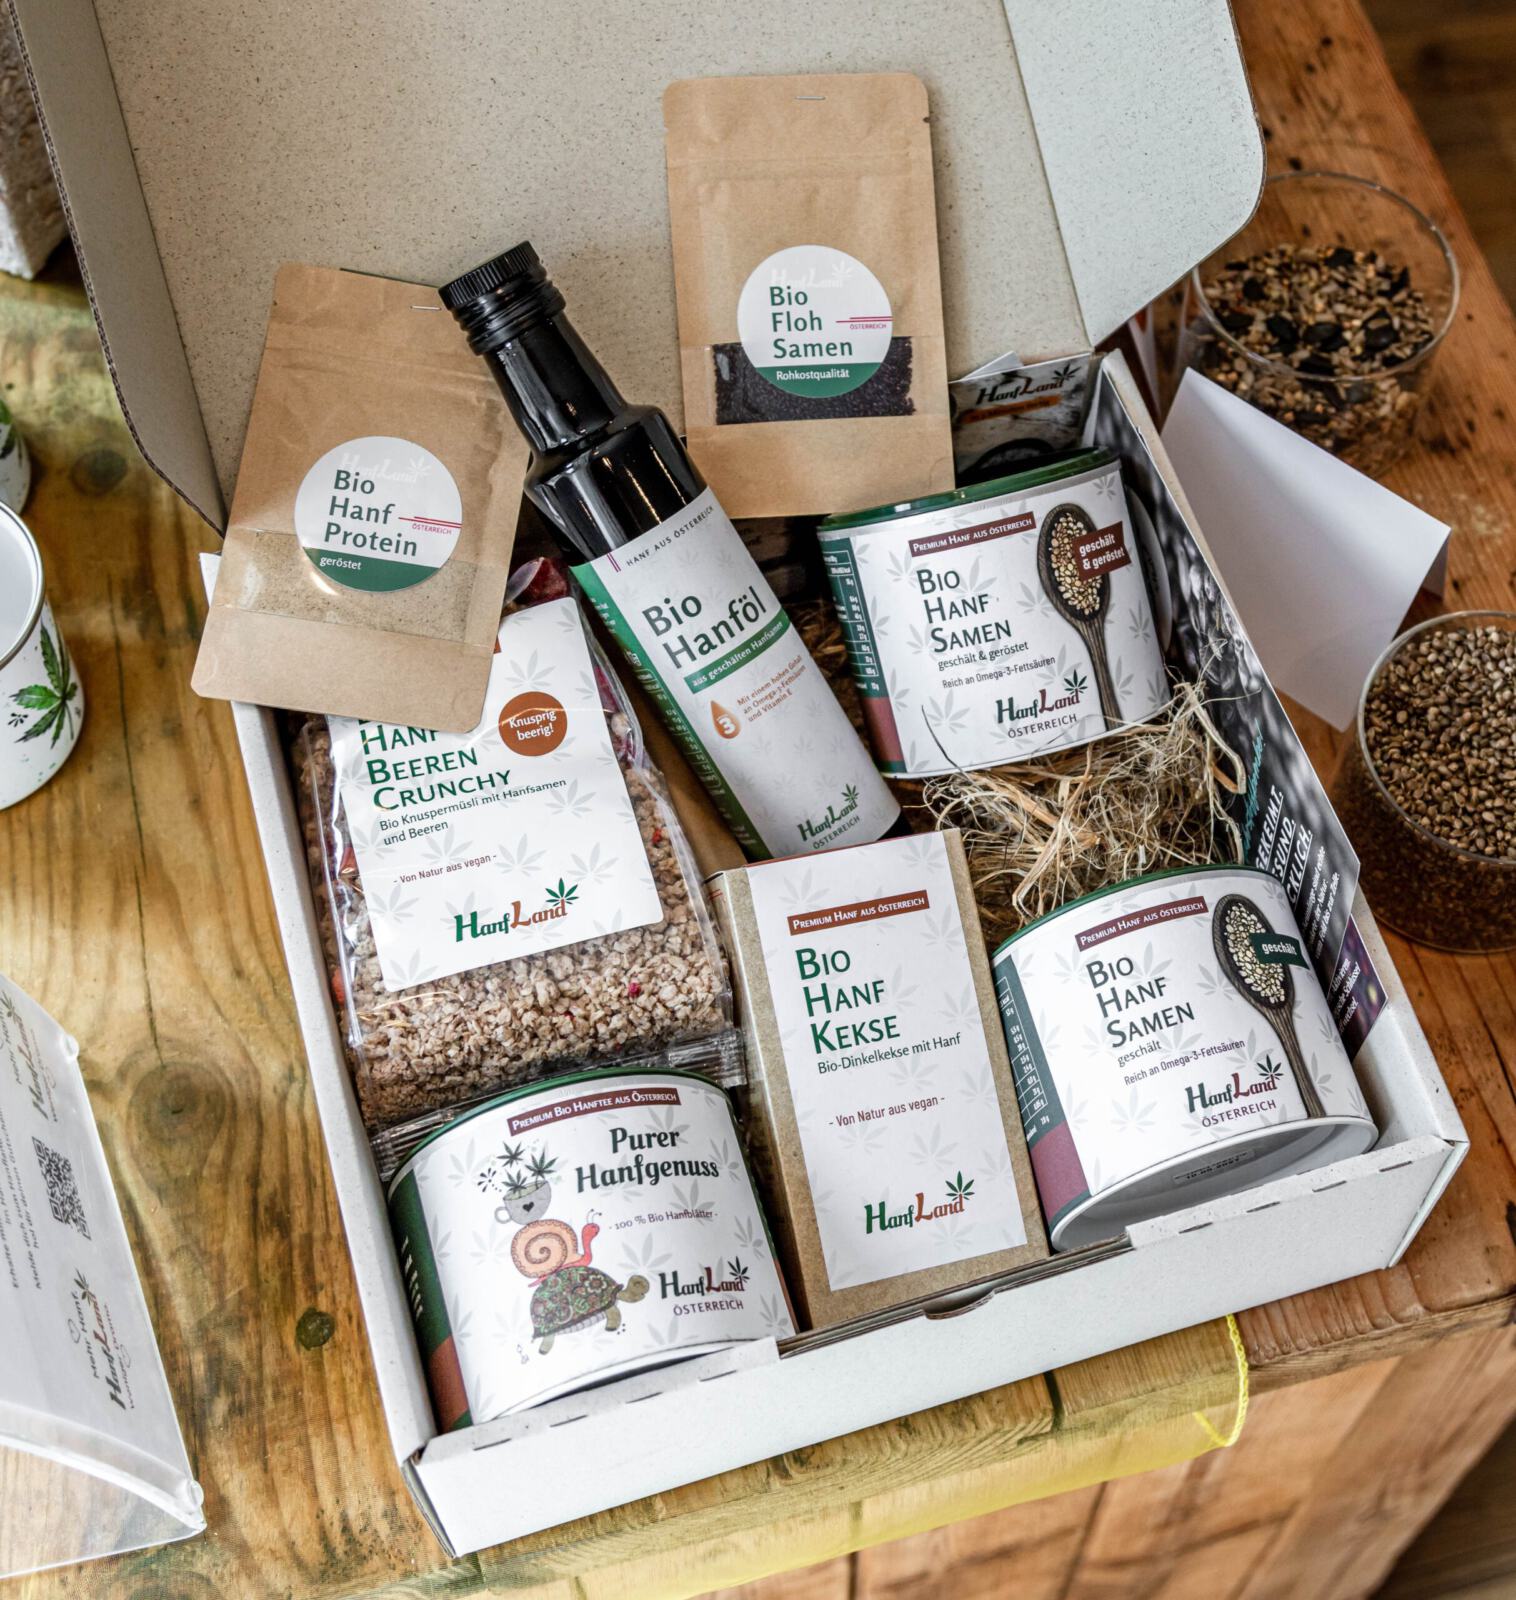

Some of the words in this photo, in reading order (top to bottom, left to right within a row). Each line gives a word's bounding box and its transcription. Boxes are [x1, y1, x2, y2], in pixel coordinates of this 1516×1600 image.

[769, 285, 808, 306] Bio
[771, 310, 823, 332] Floh
[773, 338, 853, 359] Samen
[776, 368, 850, 381] Rohkostqualität
[333, 469, 375, 495] Bio
[329, 495, 395, 525] Hanf
[324, 522, 418, 557] Protein
[626, 549, 650, 567] HANF
[653, 536, 672, 551] AUS
[673, 505, 714, 538] ÖSTERREICH
[912, 537, 948, 553] PREMIUM
[948, 530, 971, 544] HANF
[972, 528, 988, 539] AUS
[989, 517, 1033, 535] ÖSTERREICH
[1078, 533, 1116, 557] geschält
[319, 556, 362, 570] geröstet
[1082, 559, 1091, 570] &
[1092, 547, 1125, 569] geröstet
[916, 568, 960, 595] BIO
[641, 595, 702, 637] Bio
[923, 593, 989, 624] HANF
[662, 585, 767, 670] Hanföl
[930, 619, 1012, 653] SAMEN
[692, 674, 708, 687] aus
[708, 648, 752, 681] geschälten
[938, 652, 977, 672] geschält
[978, 649, 988, 661] &
[988, 641, 1029, 662] geröstet
[942, 677, 964, 689] Reich
[965, 676, 976, 685] an
[976, 656, 1056, 683] Omega-3-Fettsäuren
[508, 709, 557, 730] Knusprig
[516, 722, 554, 741] beerig!
[718, 715, 735, 734] 3
[1007, 713, 1078, 740] ÖSTERREICH
[366, 747, 478, 784] BEEREN
[372, 769, 511, 812] CRUNCHY
[379, 818, 399, 831] Bio
[401, 798, 479, 826] Knuspermüsli
[481, 793, 501, 806] mit
[502, 778, 567, 801] Hanfsamen
[383, 832, 406, 846] und
[408, 819, 449, 838] Beeren
[812, 815, 860, 849] ÖSTERREICH
[400, 871, 417, 884] Von
[418, 865, 444, 880] Natur
[446, 861, 462, 873] aus
[463, 854, 491, 869] vegan
[454, 898, 568, 942] HanfLand
[792, 916, 832, 930] PREMIUM
[834, 909, 858, 922] HANF
[860, 906, 876, 917] AUS
[877, 897, 925, 913] ÖSTERREICH
[1080, 925, 1116, 946] PREMIUM
[1117, 917, 1140, 931] HANF
[1143, 912, 1159, 922] AUS
[1159, 900, 1204, 918] ÖSTERREICH
[795, 947, 850, 980] BIO
[1086, 956, 1134, 989] BIO
[803, 979, 885, 1017] HANF
[1096, 976, 1167, 1019] HANF
[810, 1015, 900, 1055] KEKSE
[1106, 1002, 1195, 1048] SAMEN
[818, 1045, 909, 1074] Bio-Dinkelkekse
[912, 1040, 930, 1054] mit
[932, 1032, 961, 1050] Hanf
[1116, 1039, 1161, 1068] geschält
[1123, 1070, 1148, 1086] Reich
[1149, 1065, 1160, 1076] an
[1160, 1039, 1246, 1072] Omega-3-Fettsäuren
[512, 1112, 553, 1130] PREMIUM
[573, 1098, 612, 1112] HANFTEE
[615, 1095, 630, 1104] AUS
[632, 1089, 677, 1103] ÖSTERREICH
[835, 1113, 855, 1127] Von
[857, 1106, 886, 1122] Natur
[888, 1103, 906, 1115] aus
[908, 1095, 938, 1112] vegan
[1201, 1099, 1276, 1128] ÖSTERREICH
[609, 1127, 681, 1153] Purer
[575, 1153, 719, 1193] Hanfgenuss
[614, 1220, 633, 1231] 100
[637, 1215, 647, 1225] %
[647, 1212, 664, 1223] Bio
[665, 1209, 713, 1221] Hanfblätter
[863, 1192, 964, 1234] HanfLand
[673, 1299, 744, 1316] ÖSTERREICH
